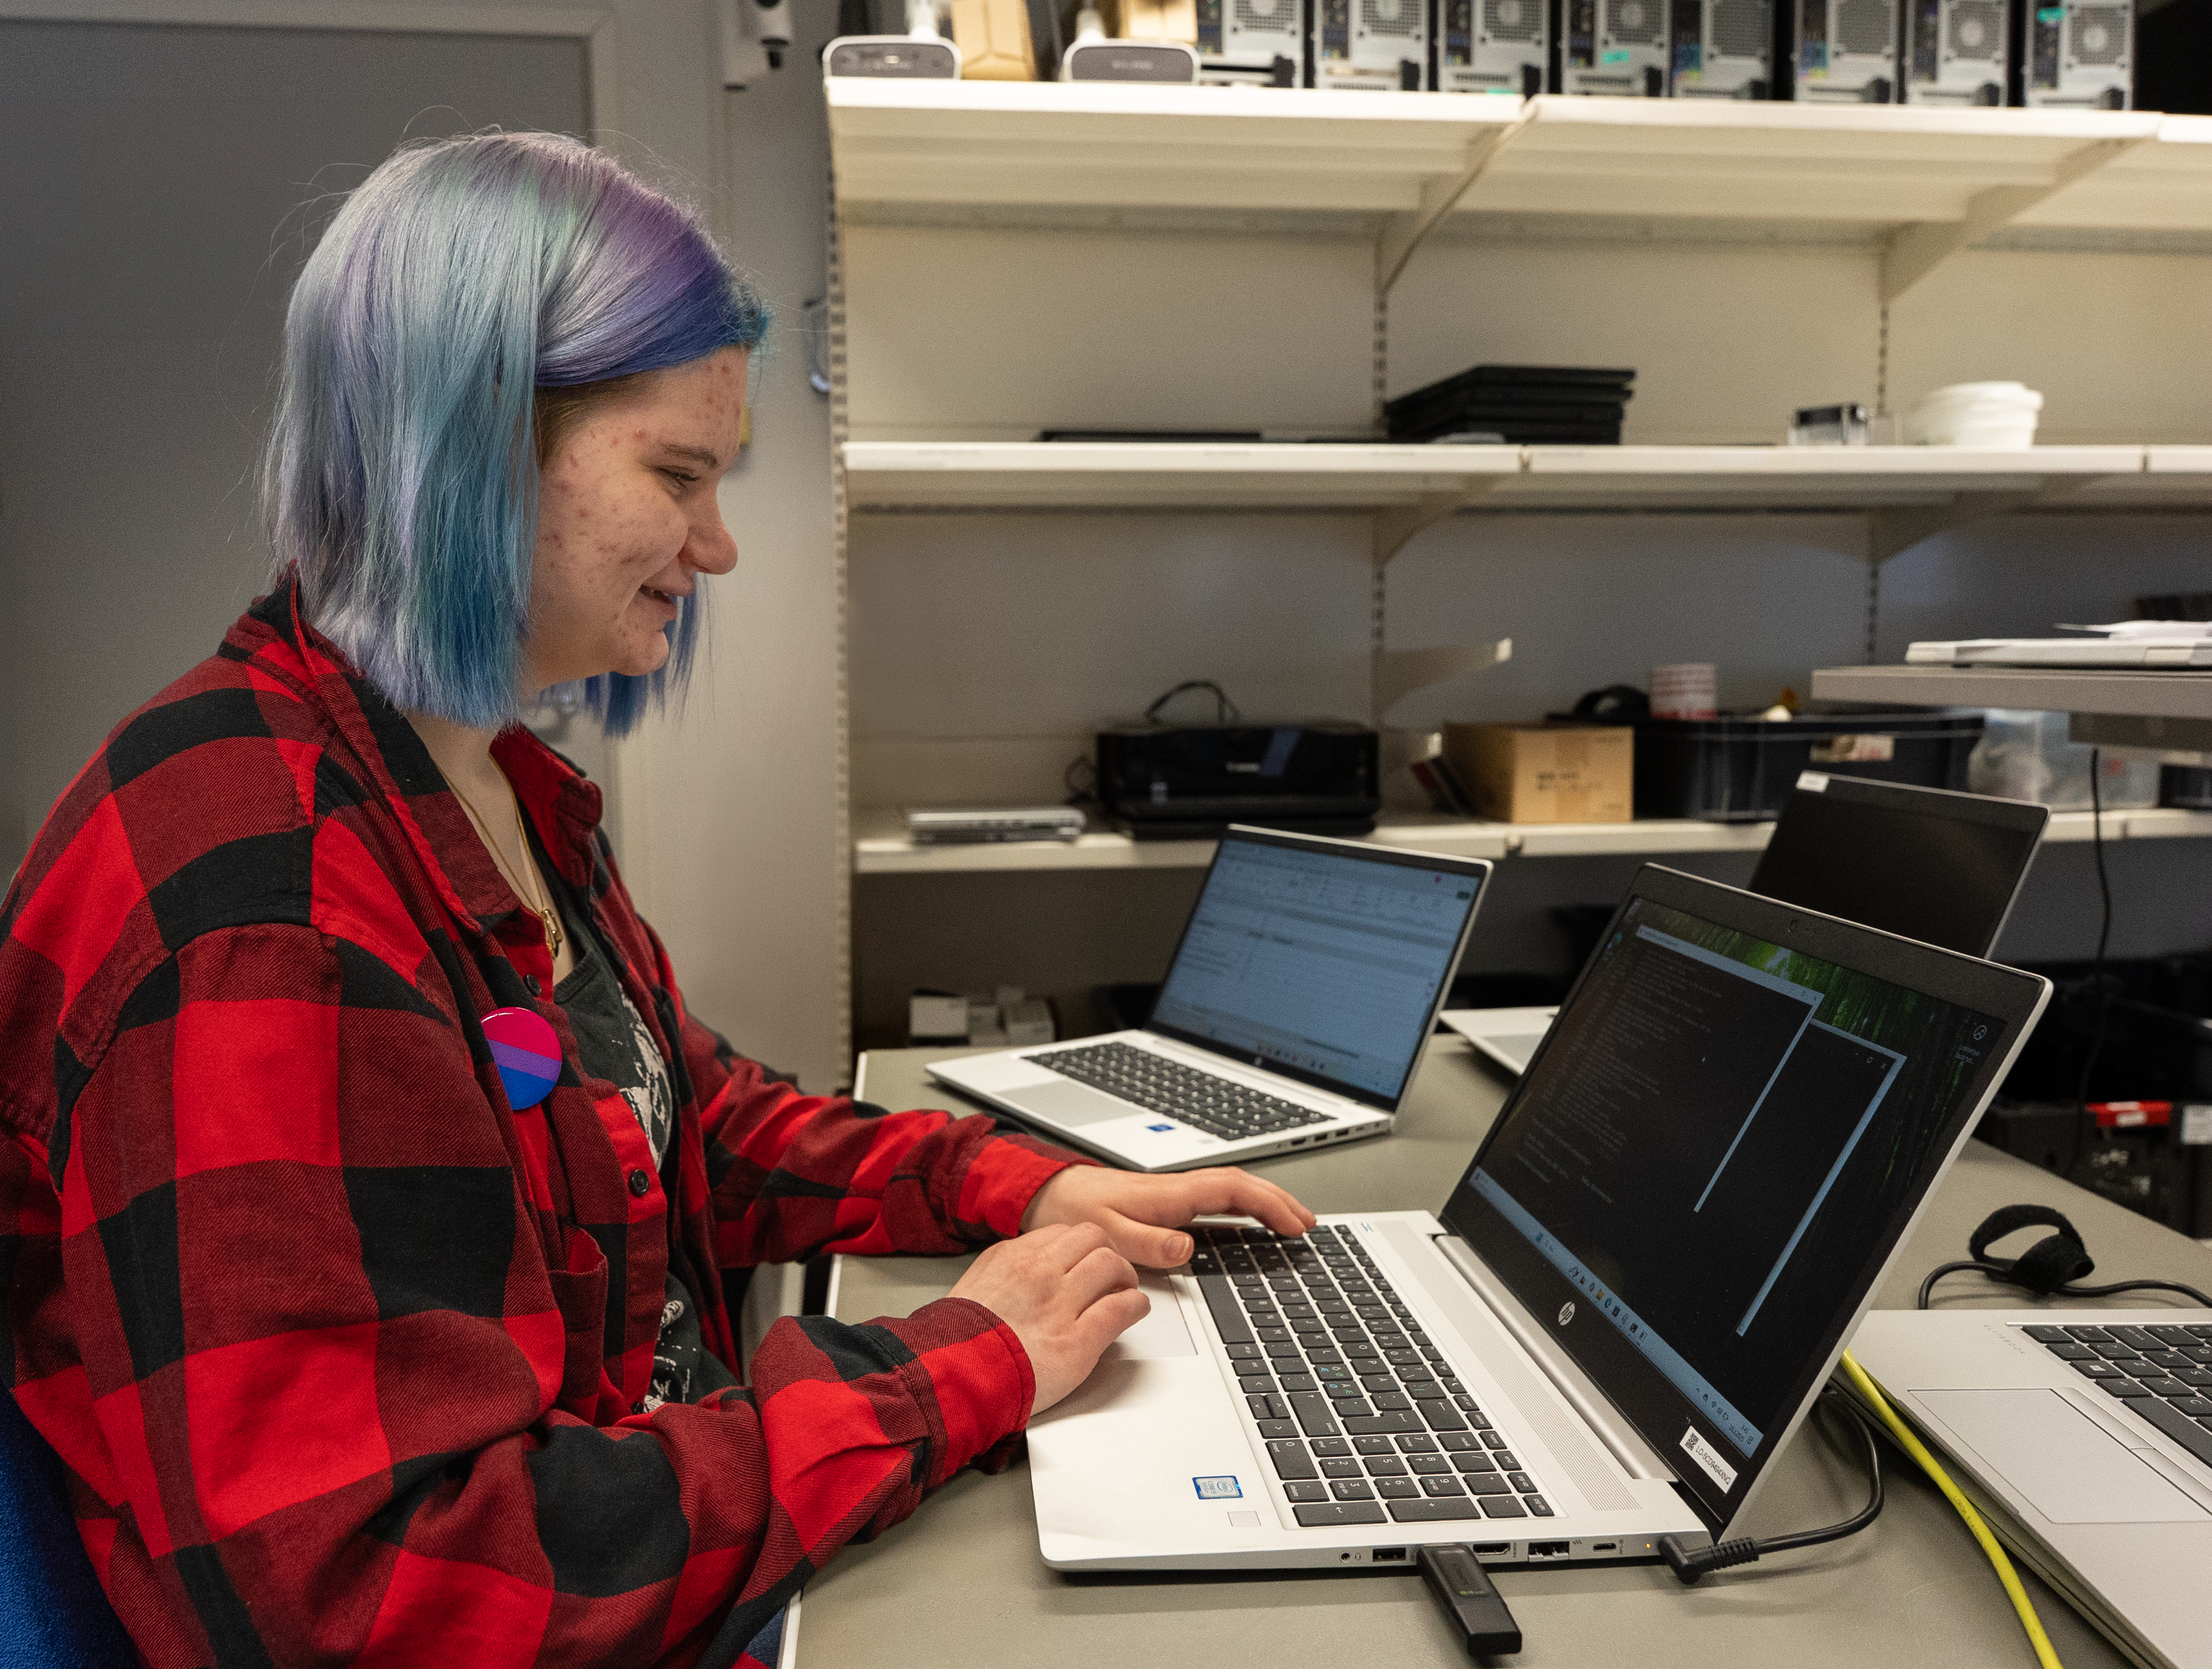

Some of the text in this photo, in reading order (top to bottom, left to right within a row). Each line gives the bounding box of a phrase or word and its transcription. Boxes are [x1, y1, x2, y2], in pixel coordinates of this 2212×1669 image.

[1559, 1302, 1575, 1325] hp
[1325, 1422, 1335, 1433] pause
[1318, 1440, 1327, 1449] end
[1404, 1436, 1413, 1447] home
[1271, 1442, 1280, 1453] insert
[1289, 1484, 1299, 1497] delete
